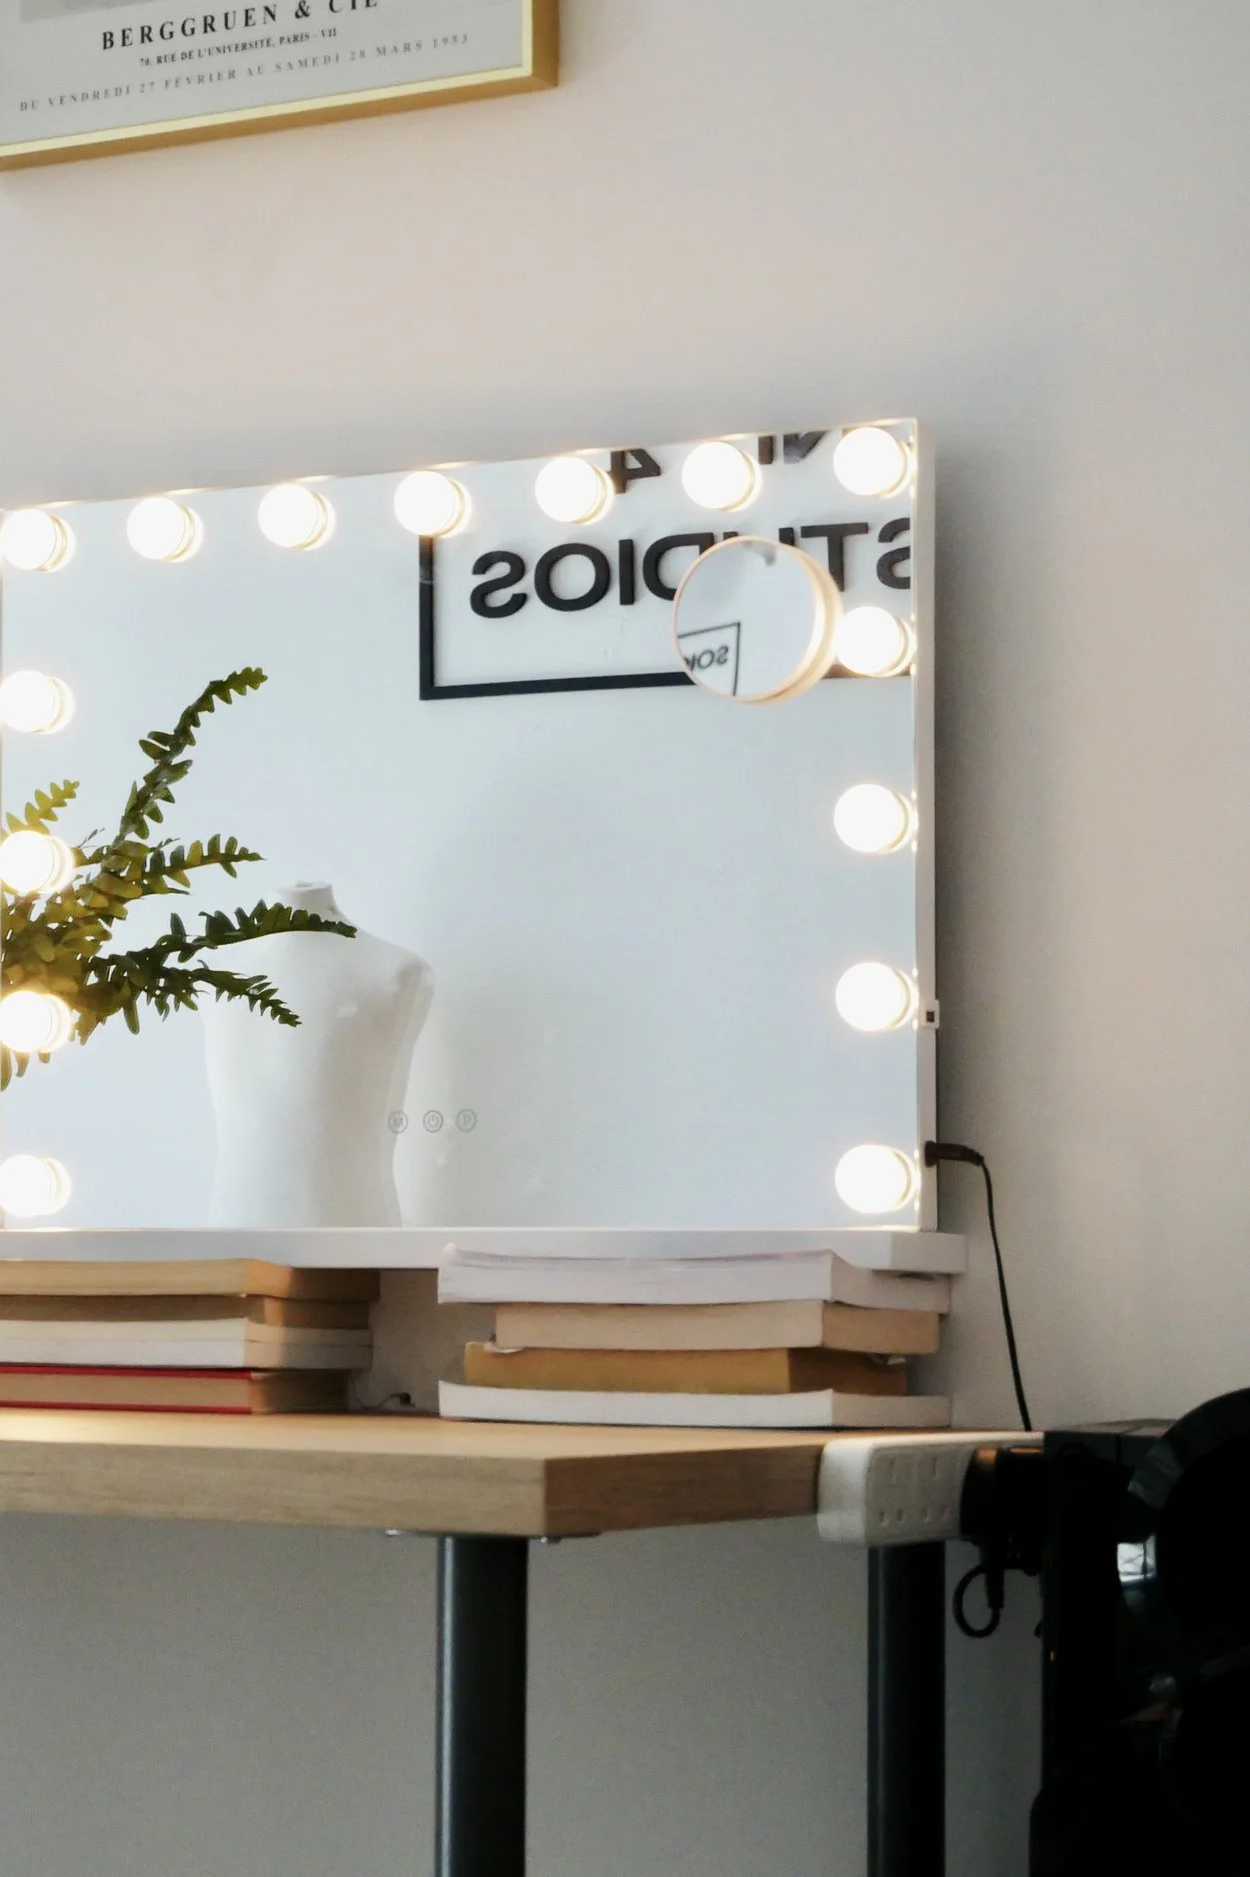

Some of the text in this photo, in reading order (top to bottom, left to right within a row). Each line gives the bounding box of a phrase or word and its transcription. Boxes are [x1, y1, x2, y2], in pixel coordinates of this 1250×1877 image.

[102, 4, 278, 50] BERGGRUEN
[294, 0, 310, 19] &
[156, 52, 177, 65] RUE
[180, 50, 194, 61] DE
[279, 31, 310, 46] PARIS
[20, 100, 39, 112] DU
[48, 85, 131, 108] VENDREDI
[139, 82, 155, 94] 27
[247, 65, 265, 77] AU
[275, 53, 341, 73] SAMEDI
[349, 48, 366, 62] 28
[376, 39, 422, 56] MARS
